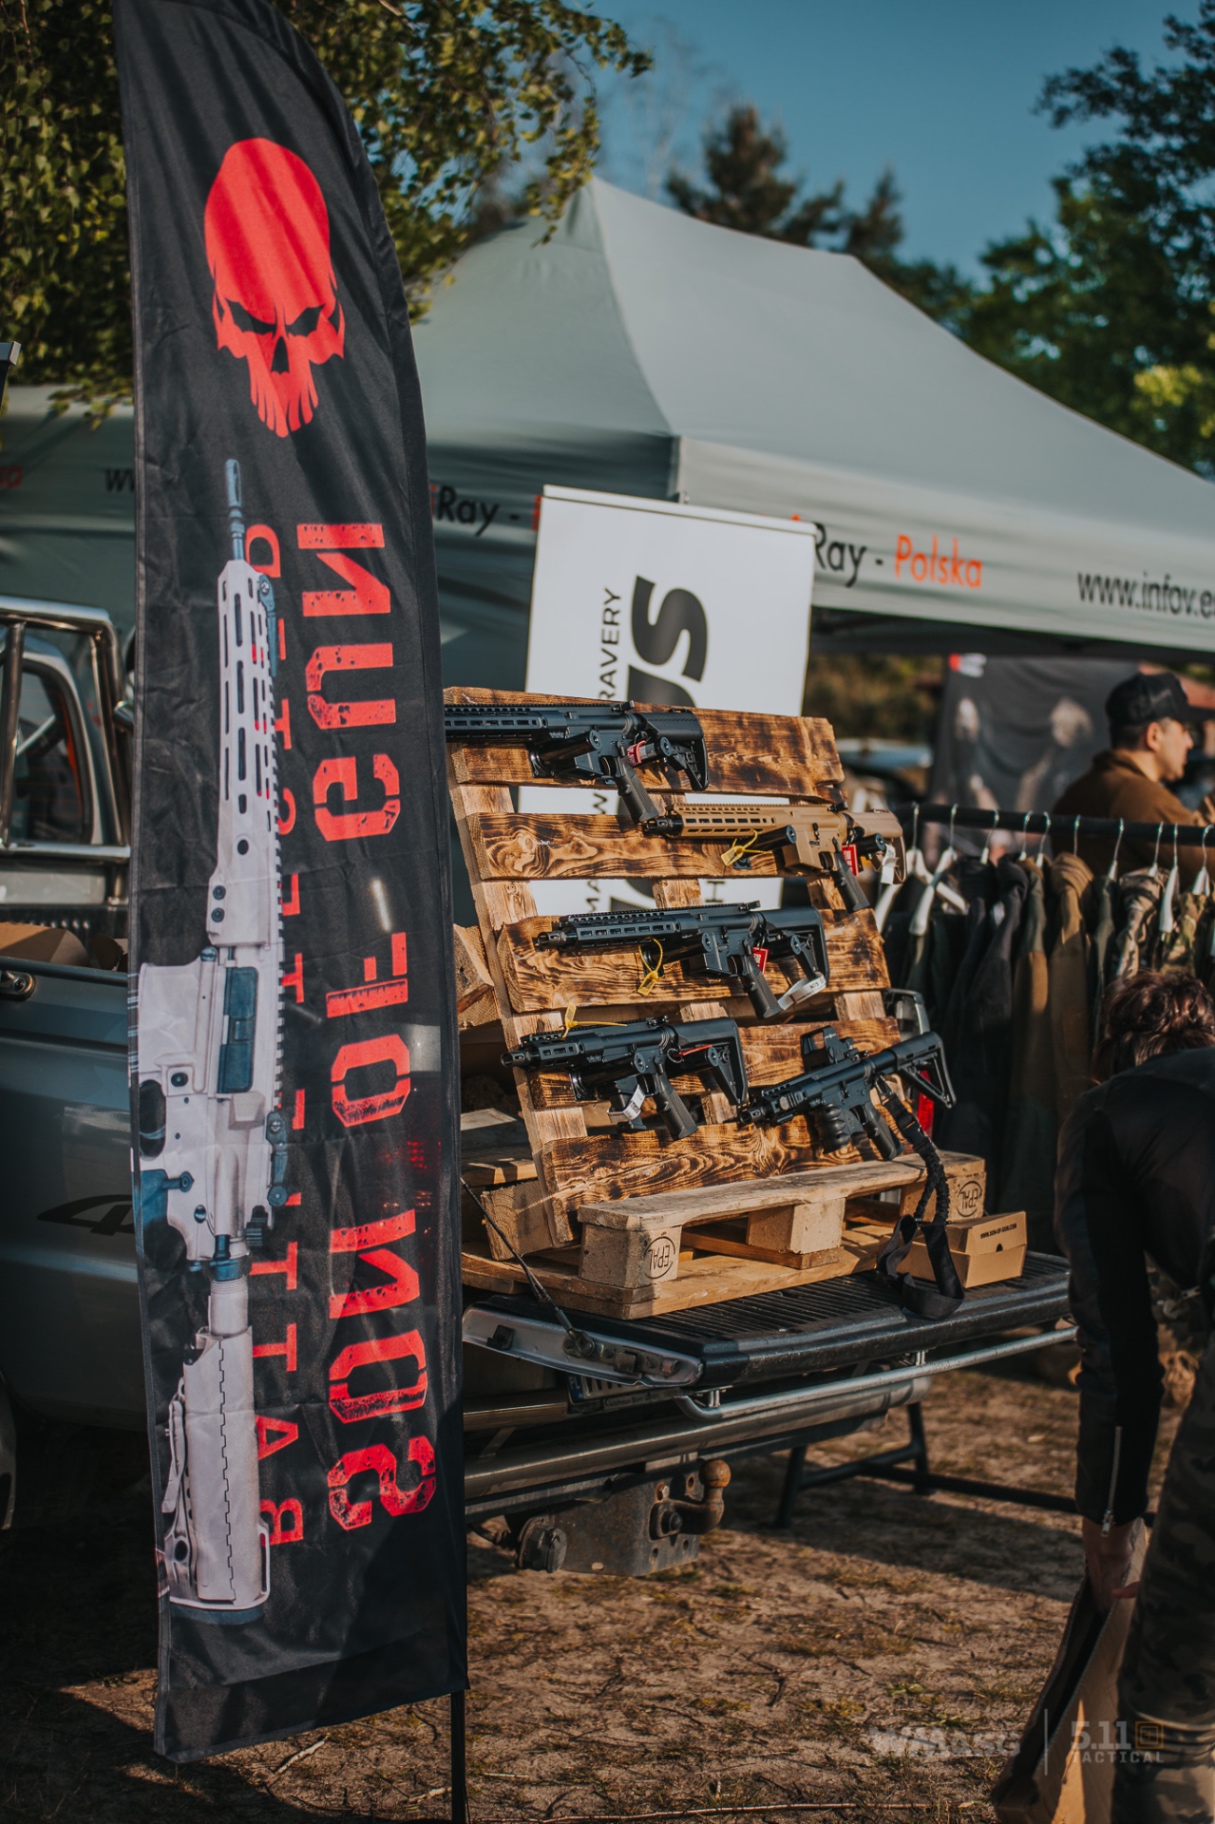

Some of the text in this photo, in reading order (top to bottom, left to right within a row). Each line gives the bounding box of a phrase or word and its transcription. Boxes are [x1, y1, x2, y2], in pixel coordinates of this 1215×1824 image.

[894, 532, 983, 589] Polska
[1077, 570, 1215, 619] www.infov.e
[648, 1244, 670, 1271] EPAL
